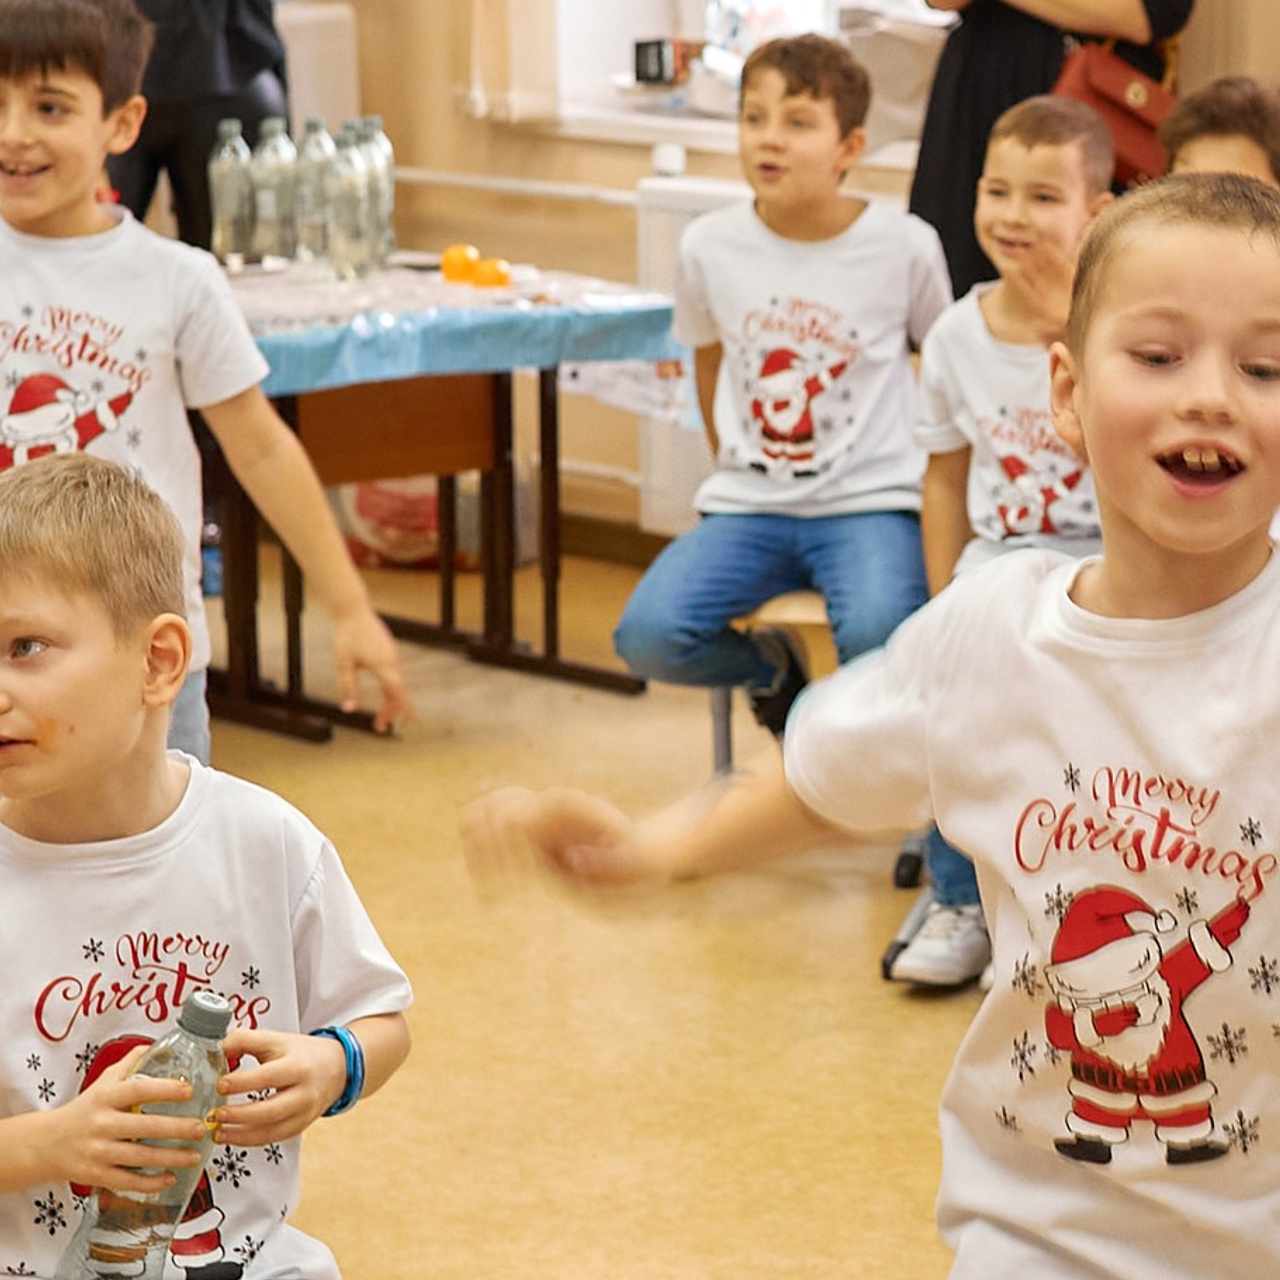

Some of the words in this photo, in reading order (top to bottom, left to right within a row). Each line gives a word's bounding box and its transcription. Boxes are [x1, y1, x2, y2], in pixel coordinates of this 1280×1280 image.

[1091, 766, 1221, 825] Merry
[1013, 797, 1279, 900] Christmas
[115, 931, 230, 976] Merry
[34, 962, 271, 1042] Christas
